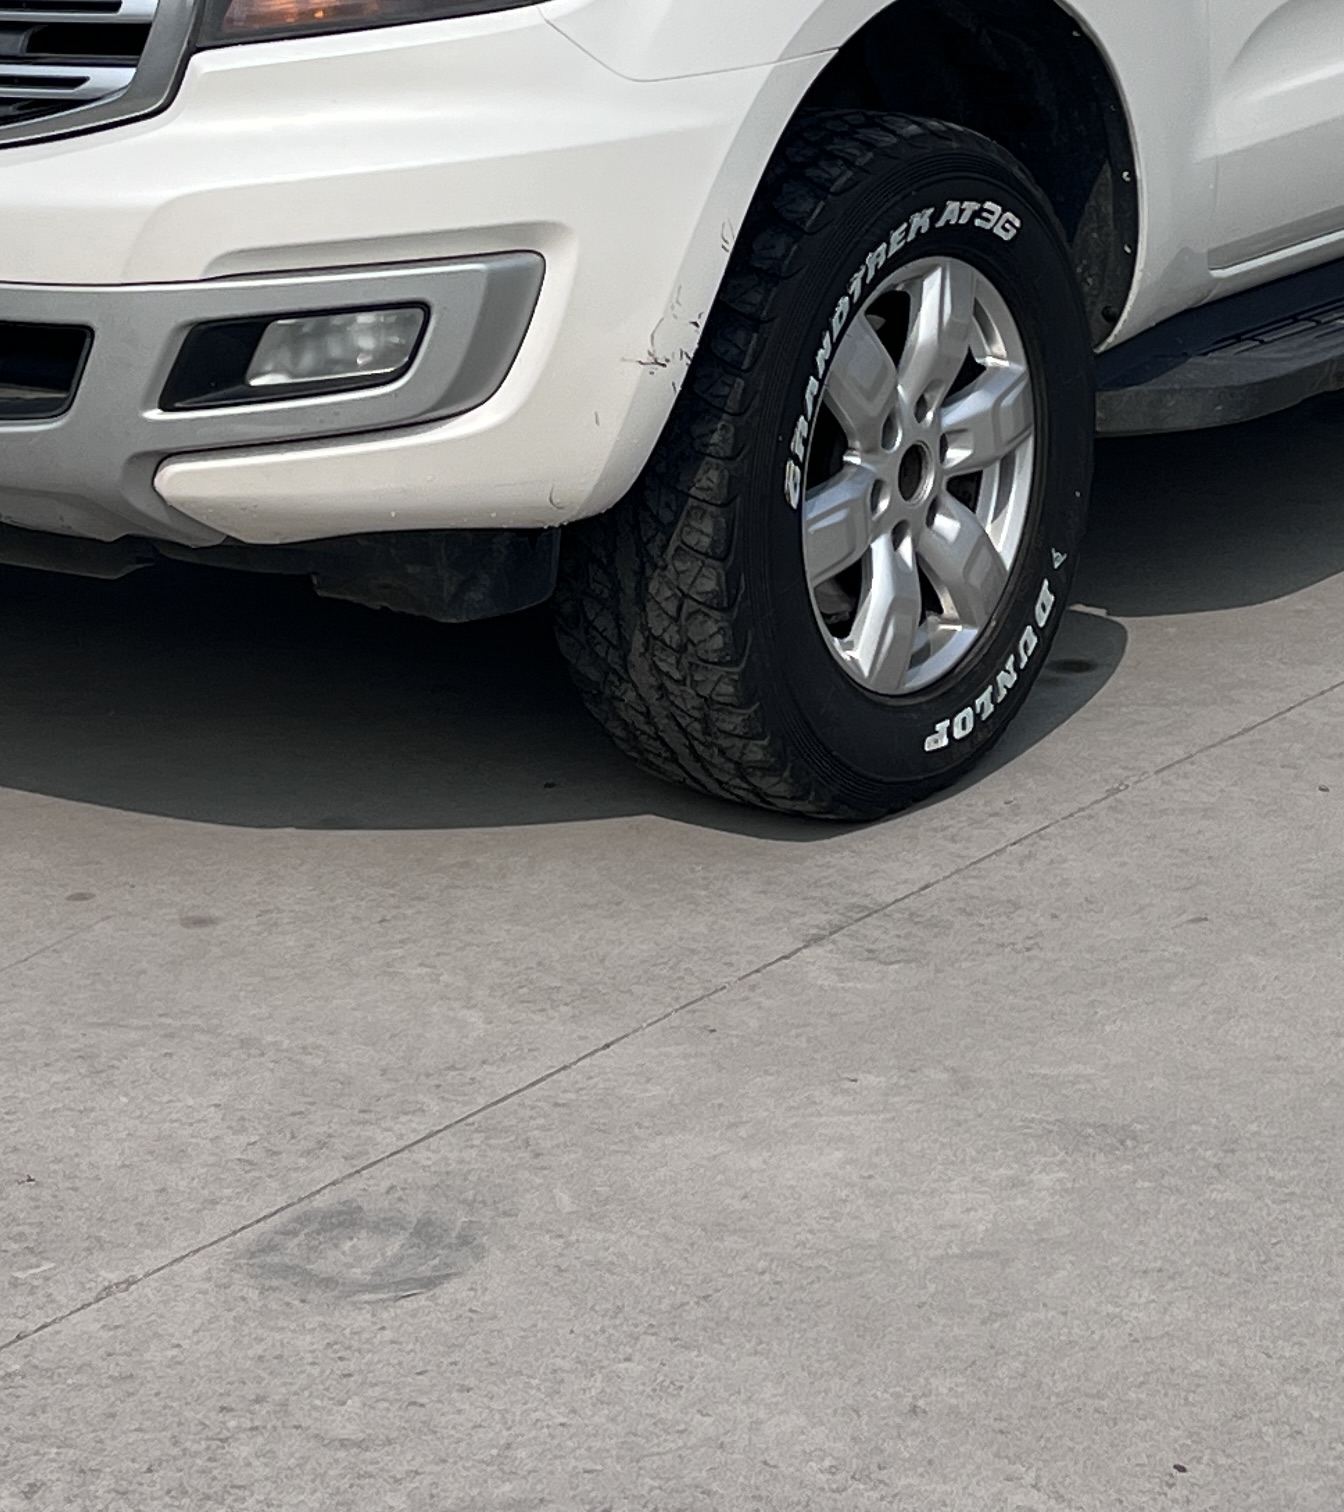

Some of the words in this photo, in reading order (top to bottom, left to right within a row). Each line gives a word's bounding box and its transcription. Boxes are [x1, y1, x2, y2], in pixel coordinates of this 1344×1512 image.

[784, 207, 935, 510] GRANDTREK
[935, 200, 1022, 241] AT3G
[923, 577, 1055, 751] DUNLOP
